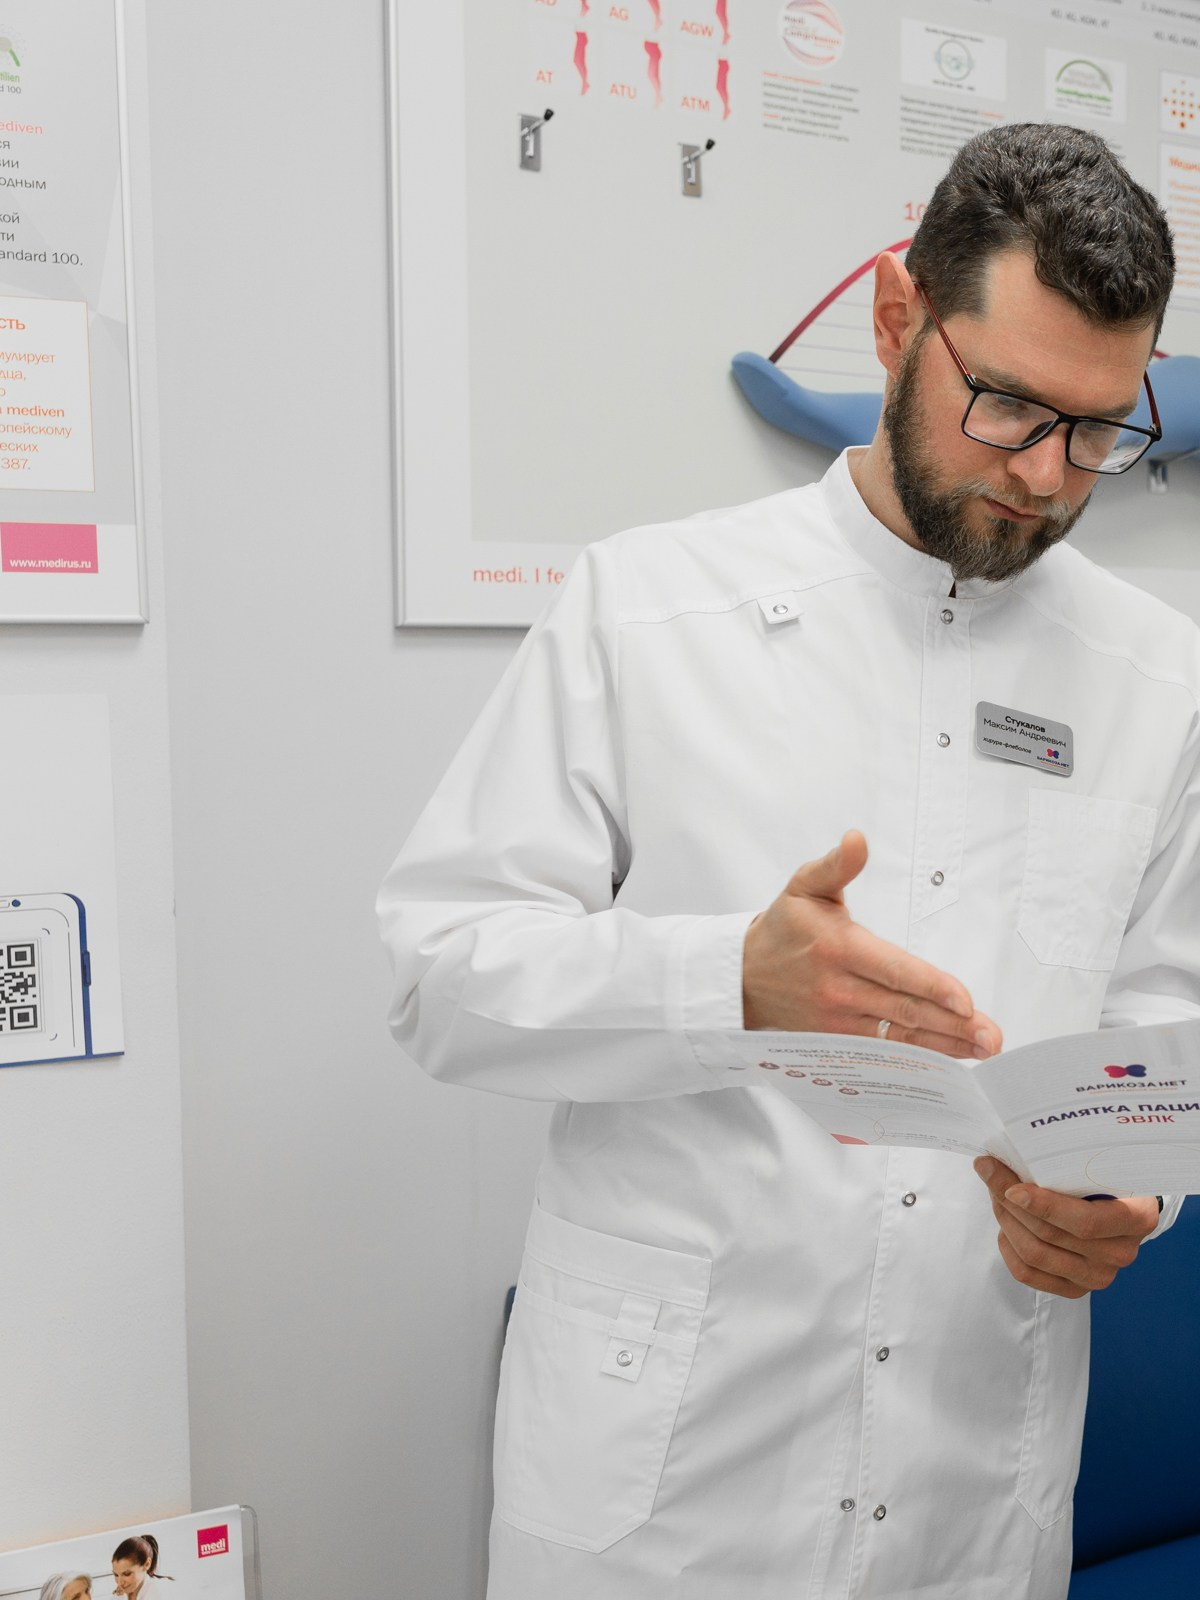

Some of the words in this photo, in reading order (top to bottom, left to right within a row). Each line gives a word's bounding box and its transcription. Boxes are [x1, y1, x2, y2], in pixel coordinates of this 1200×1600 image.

[609, 6, 629, 21] AG
[681, 20, 714, 37] AGW
[536, 70, 553, 84] AT
[7, 86, 22, 94] 100
[610, 83, 637, 99] ATU
[681, 97, 710, 112] ATM
[0, 159, 19, 168] ии
[52, 252, 83, 267] 100.
[7, 405, 65, 419] mediven
[1, 458, 31, 471] 387.
[10, 557, 91, 569] www.medirus.ru
[473, 567, 527, 583] medi.
[1004, 715, 1046, 733] Стукалов
[983, 718, 1018, 734] Максим
[1019, 728, 1067, 748] Андреевич
[1076, 1081, 1157, 1093] ВАРИКОЗА
[1158, 1079, 1188, 1087] НЕТ
[1030, 1103, 1131, 1129] ПАМЯТКА
[1116, 1115, 1175, 1125] ЭВЛК
[200, 1537, 226, 1552] medi
